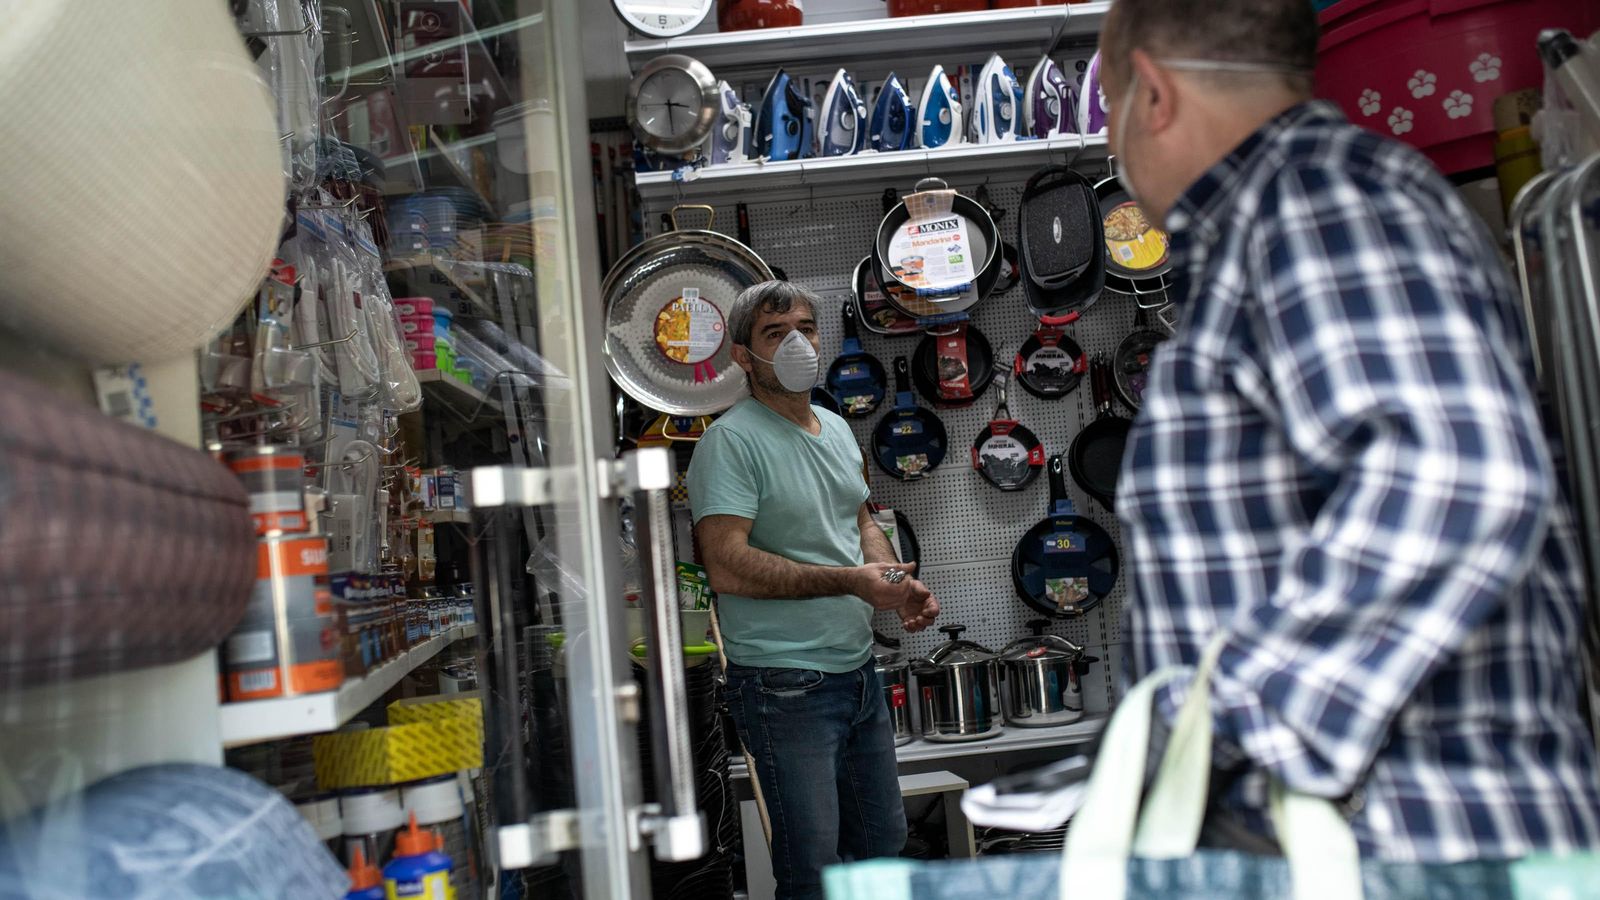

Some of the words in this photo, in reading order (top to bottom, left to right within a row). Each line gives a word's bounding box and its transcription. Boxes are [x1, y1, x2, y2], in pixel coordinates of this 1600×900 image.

[654, 15, 668, 25] 6
[919, 219, 959, 234] MONIX
[911, 236, 952, 249] Mandarina
[672, 302, 714, 313] PAELLA
[901, 425, 913, 435] 22
[1056, 539, 1071, 549] 30
